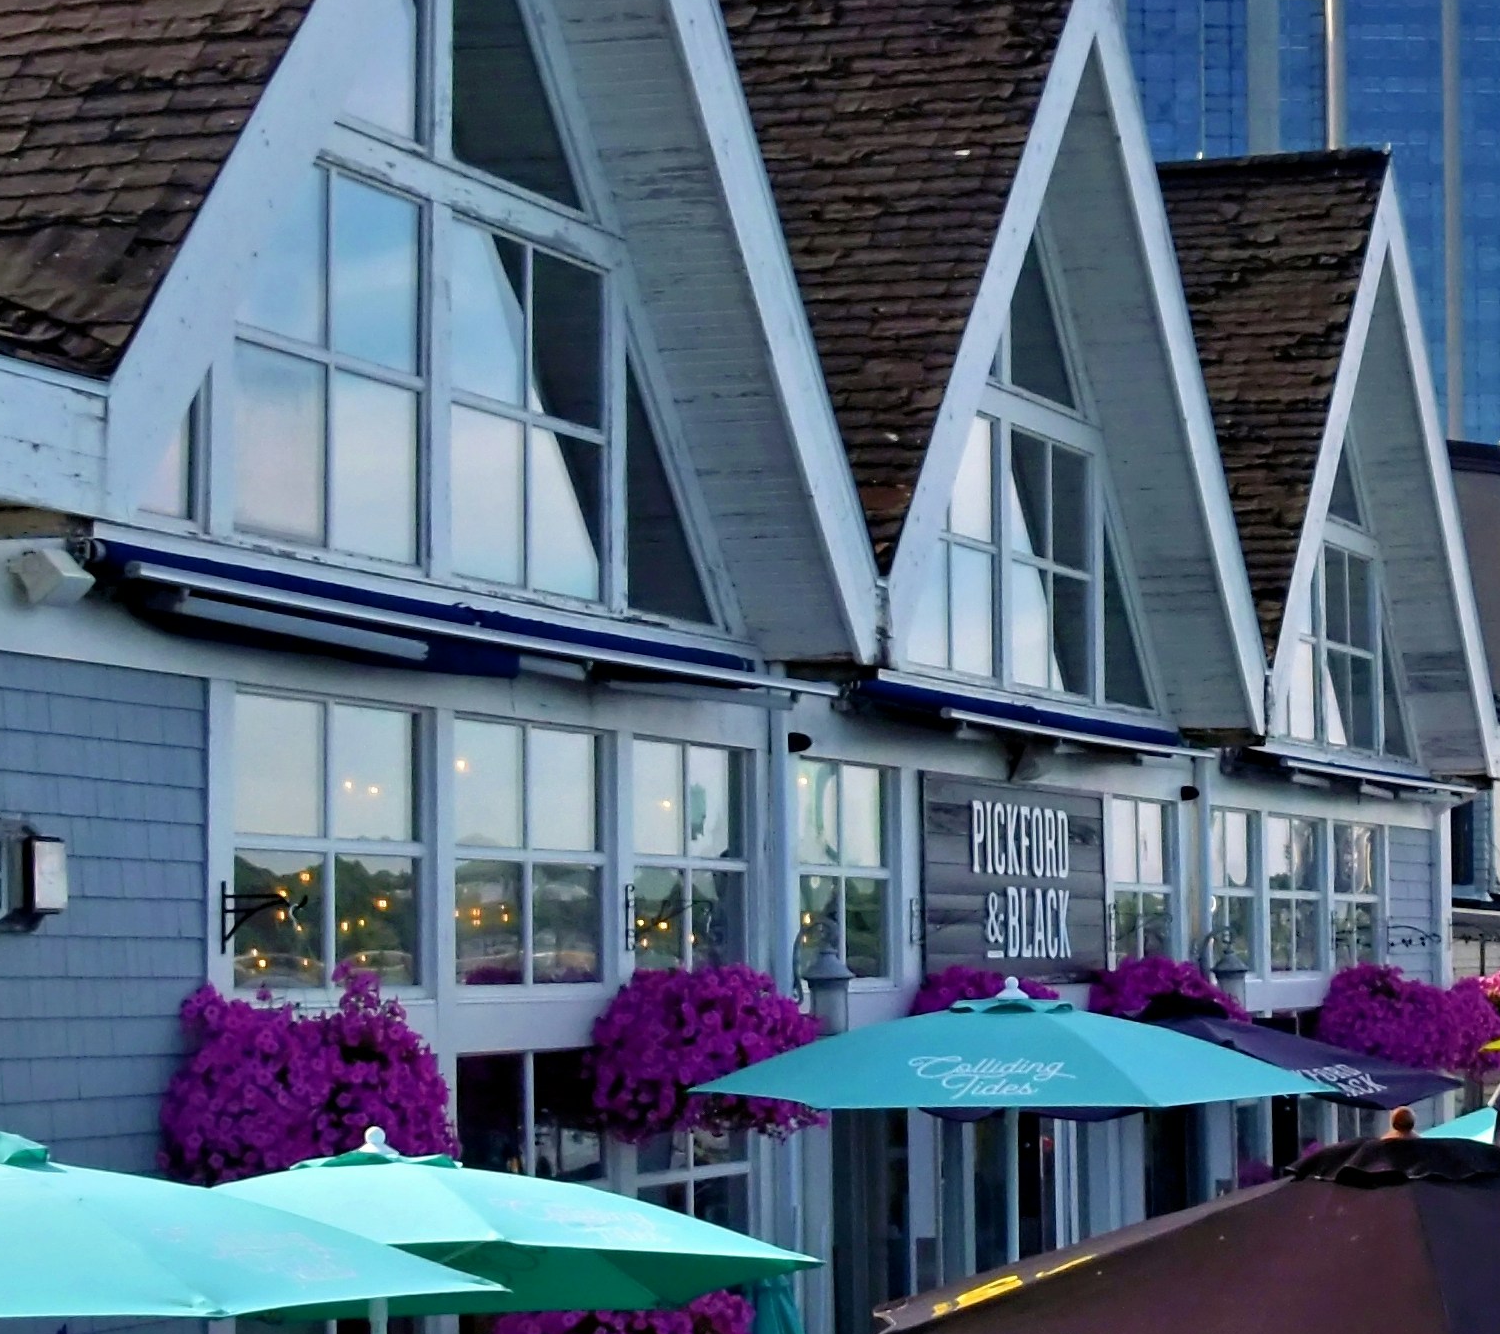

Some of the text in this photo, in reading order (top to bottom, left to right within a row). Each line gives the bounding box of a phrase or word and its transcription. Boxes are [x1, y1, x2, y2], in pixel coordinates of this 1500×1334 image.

[972, 800, 1070, 878] PICKFORD
[987, 886, 1071, 959] & BLACK
[907, 1055, 1076, 1082] Colliding
[941, 1074, 1039, 1100] Tides
